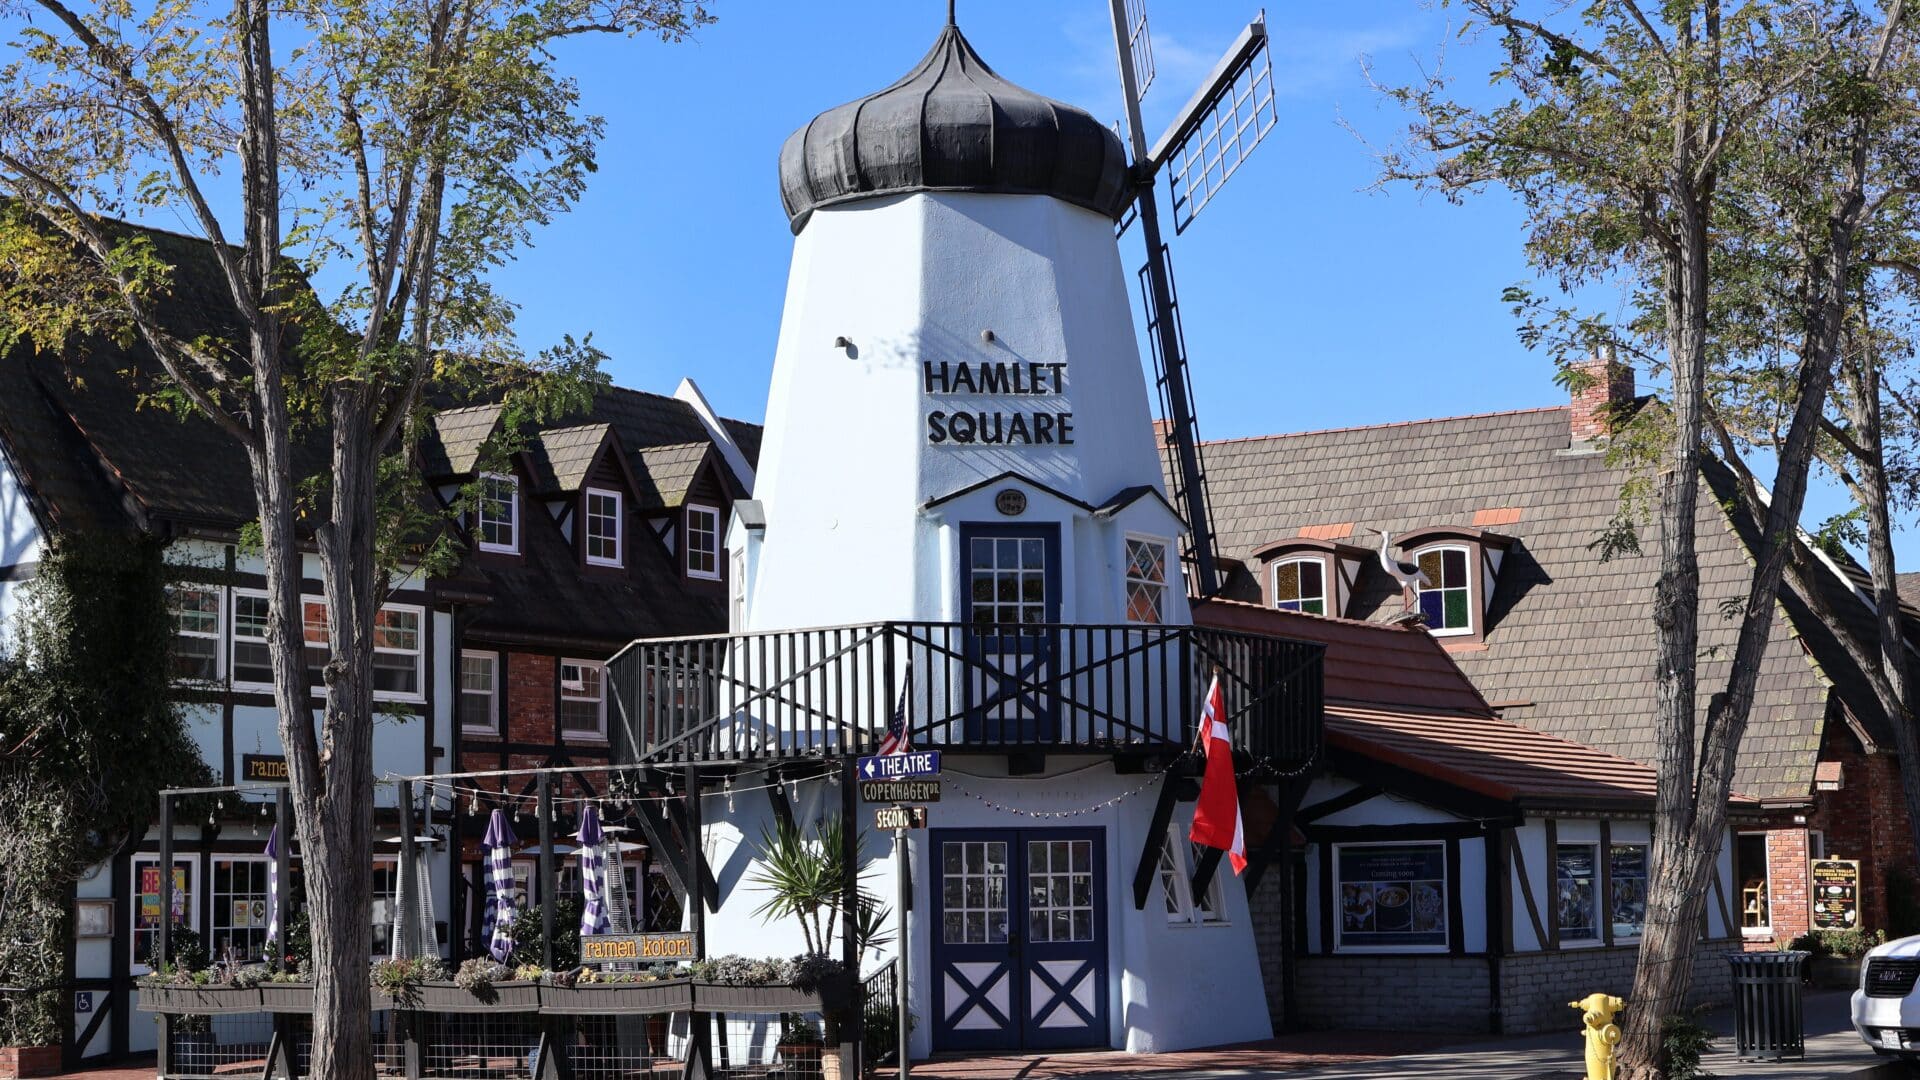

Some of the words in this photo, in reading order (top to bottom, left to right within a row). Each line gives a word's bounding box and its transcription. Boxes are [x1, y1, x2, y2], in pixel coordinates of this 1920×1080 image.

[924, 361, 1067, 394] HAMLET
[928, 410, 1074, 444] SQUARE
[250, 760, 288, 777] rame
[880, 754, 932, 776] THEATRE
[863, 783, 930, 800] COPENHAGEN
[877, 809, 909, 828] SECOND
[585, 941, 637, 958] ramen
[642, 935, 692, 957] kotori
